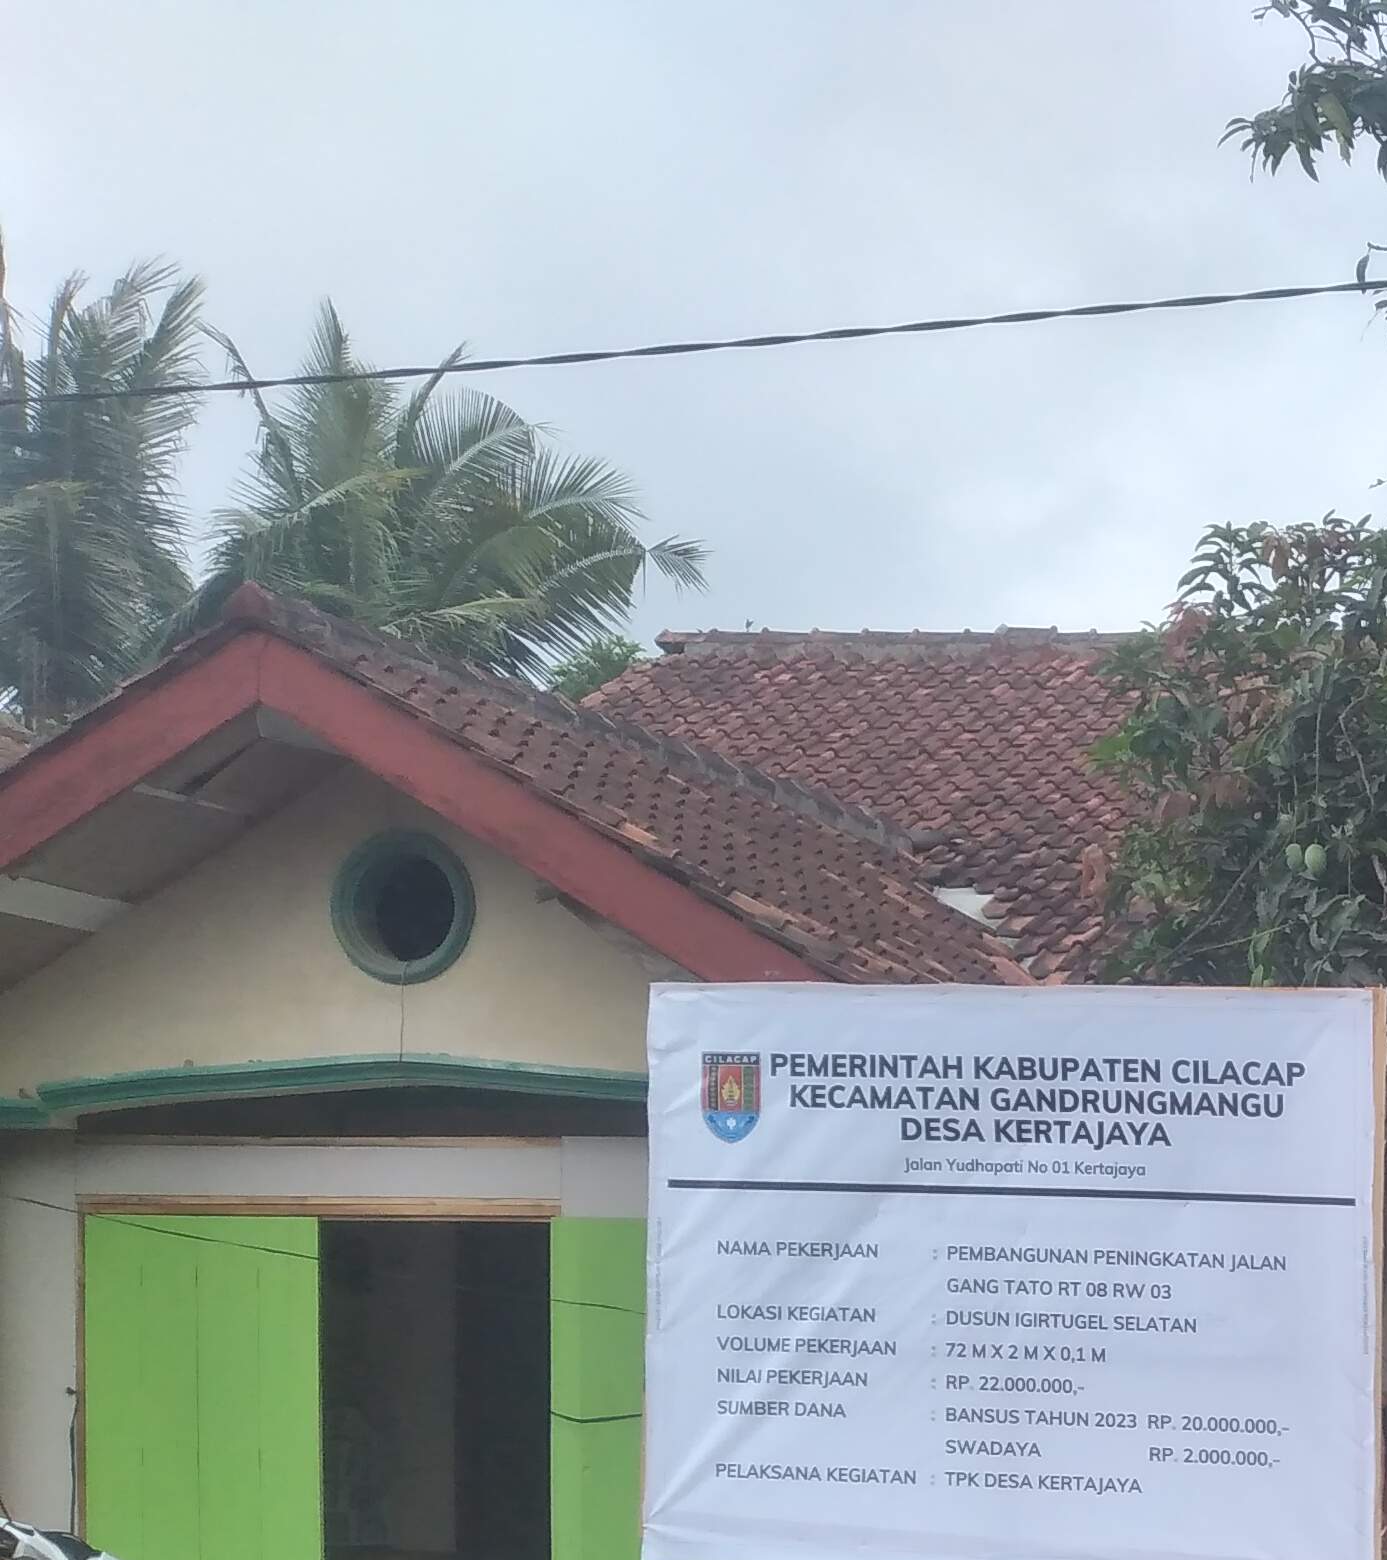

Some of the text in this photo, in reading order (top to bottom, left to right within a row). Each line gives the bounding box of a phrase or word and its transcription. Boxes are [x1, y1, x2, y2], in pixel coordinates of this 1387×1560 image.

[704, 1055, 757, 1064] CILACAP
[770, 1053, 1306, 1088] PEMERINTAH KABUPATEN CILACAP
[790, 1084, 1284, 1119] KECAMATAN GANDRUNGMANGU
[900, 1117, 1173, 1151] DESA KERTAJAYA
[904, 1157, 1146, 1179] Jalan Yudhapati No 01 Kertajaya
[718, 1240, 773, 1256] NAMA
[776, 1241, 879, 1261] PEKERJAAN
[947, 1246, 1089, 1267] PEMBANGUNAN
[1093, 1250, 1225, 1269] PENINGKATAN
[1229, 1254, 1287, 1272] JALAN
[947, 1278, 1172, 1300] GANG TATO RT 08 RW 03
[718, 1303, 783, 1321] LOKASI
[786, 1306, 877, 1323] KEGIATAN
[946, 1310, 1010, 1327] DUSUN
[1015, 1312, 1110, 1331] IGIRTUGEL
[1112, 1315, 1197, 1333] SELATAN
[716, 1335, 791, 1354] VOLUME
[795, 1337, 897, 1357] PEKERJAAN
[945, 1342, 967, 1358] 72
[971, 1343, 987, 1359] M
[989, 1344, 1004, 1360] X
[1007, 1344, 1020, 1361] 2
[1023, 1345, 1039, 1361] M
[1042, 1345, 1058, 1362] X
[1060, 1346, 1086, 1364] 0,1
[1091, 1347, 1107, 1363] M
[718, 1367, 761, 1384] NILAI
[766, 1369, 869, 1389] PEKERJAAN
[946, 1375, 974, 1392] RP.
[978, 1376, 1085, 1396] 22.000.000,-
[717, 1400, 790, 1418] SUMBER
[794, 1402, 846, 1419] DANA
[946, 1407, 1021, 1425] BANSUS
[1024, 1409, 1089, 1428] TAHUN
[1094, 1412, 1138, 1429] 2023
[1147, 1414, 1177, 1432] RP.
[1181, 1416, 1291, 1436] 20.000.000,-
[945, 1439, 1281, 1468] SWADAYA RP. 2.000.000,-
[715, 1462, 822, 1482] PELAKSANA
[826, 1467, 917, 1484] KEGIATAN
[945, 1472, 981, 1488] TPK
[984, 1473, 1034, 1490] DESA
[1038, 1475, 1144, 1495] KERTAJAYA
